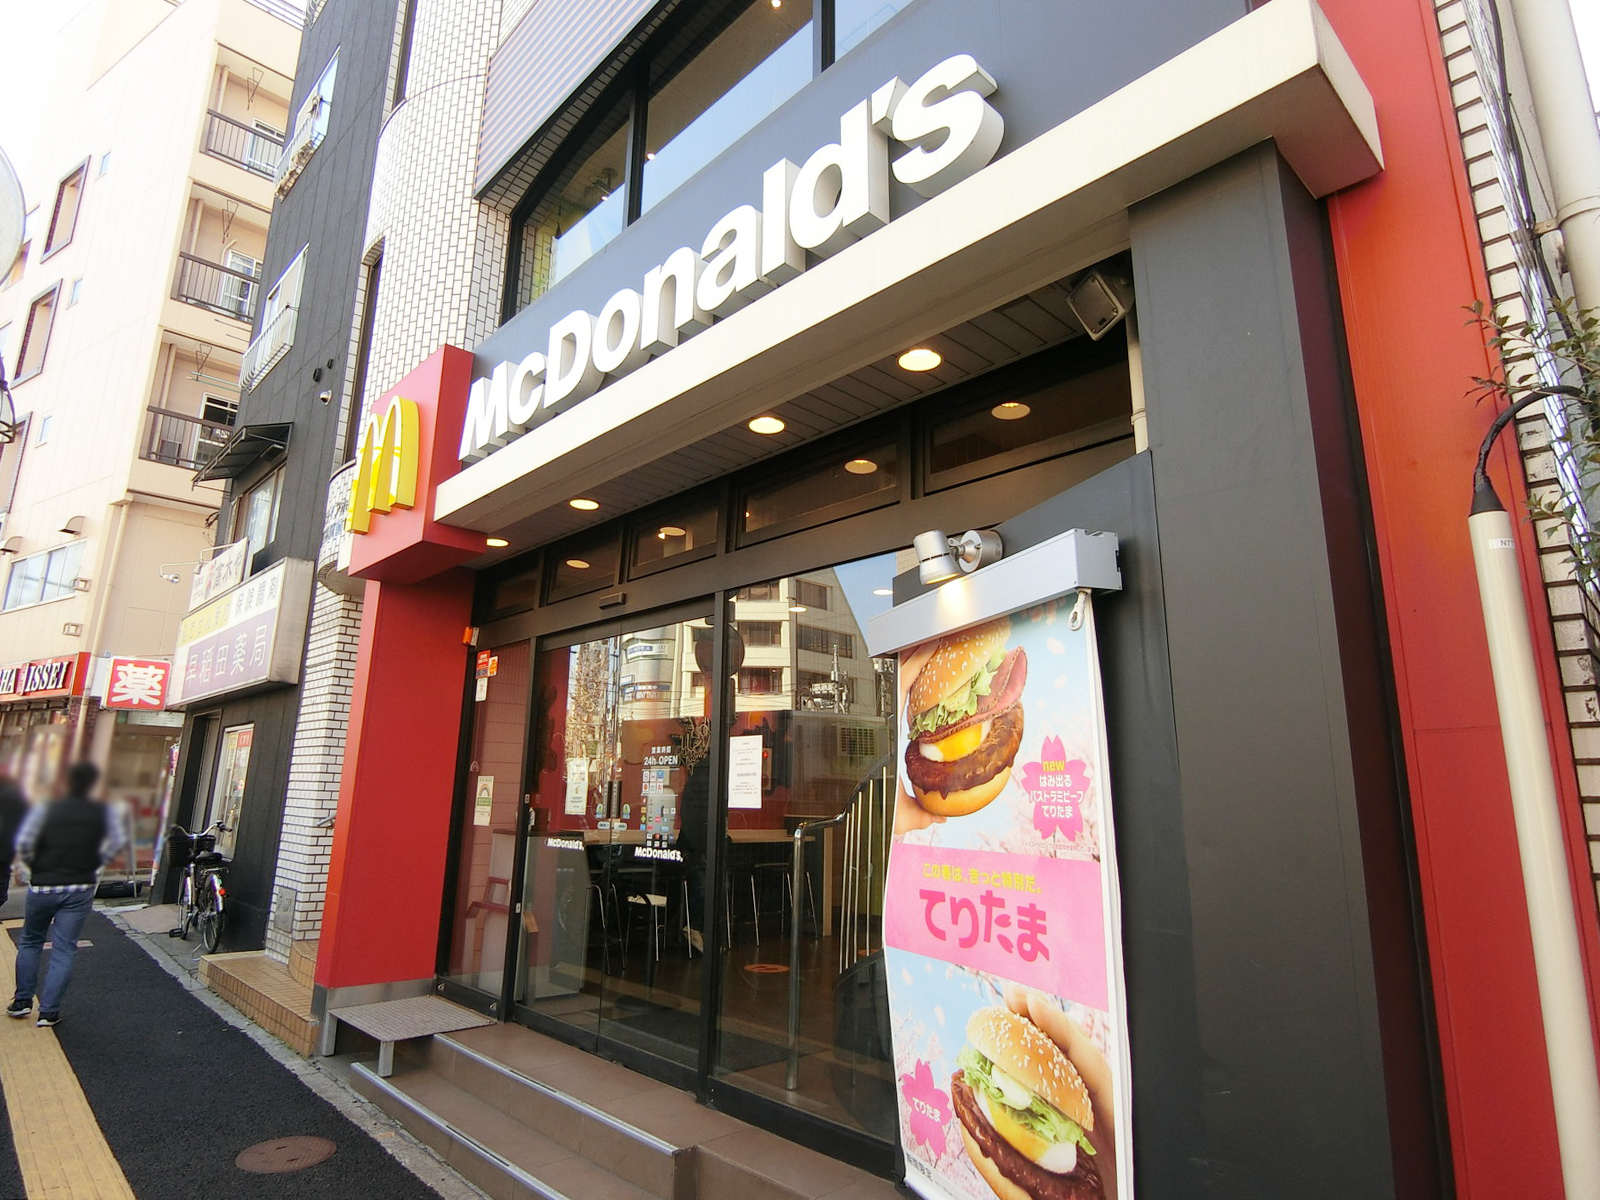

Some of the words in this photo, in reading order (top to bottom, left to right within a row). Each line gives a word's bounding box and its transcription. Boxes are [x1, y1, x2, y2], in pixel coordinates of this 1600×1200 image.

[458, 53, 1004, 462] McDonald's
[186, 624, 268, 690] 早稲田薬局
[0, 668, 16, 694] HA
[25, 661, 69, 692] ISSEI
[111, 662, 166, 705] 薬
[643, 756, 656, 766] 24h
[658, 755, 678, 766] OPEN
[651, 746, 671, 755] 営業時間
[1042, 760, 1065, 772] new
[1039, 774, 1072, 787] はみ出る
[1029, 790, 1084, 804] パストラミビーフ
[1041, 805, 1073, 818] てりたま
[922, 863, 1041, 894] この春は、きっと特別だ。
[919, 889, 1050, 962] てりたま
[912, 1096, 941, 1123] てりたま
